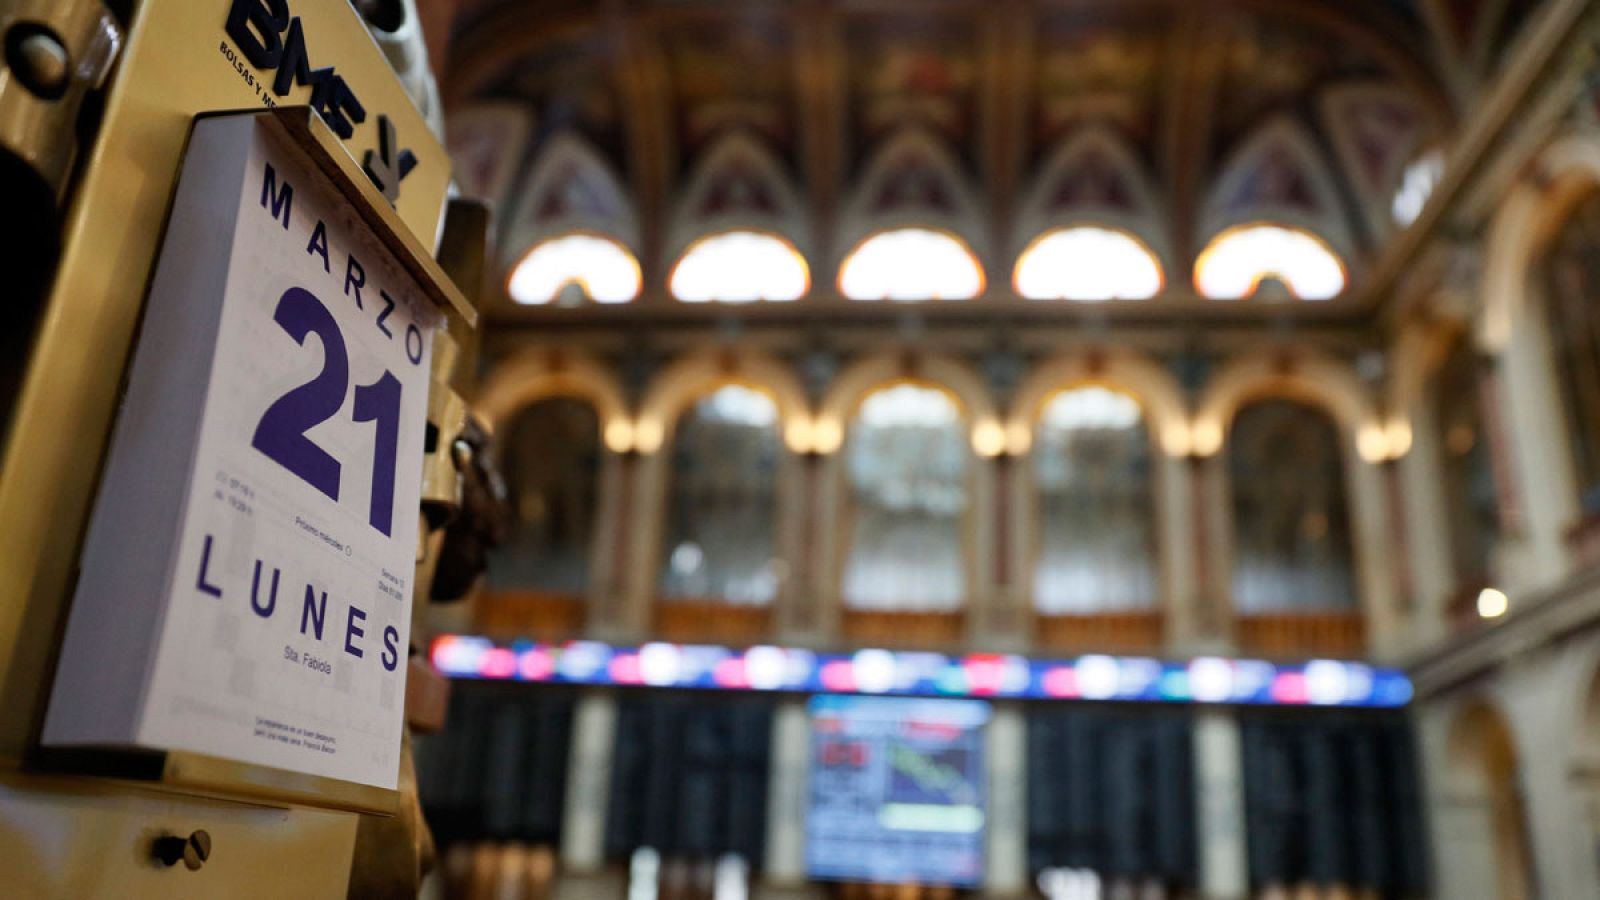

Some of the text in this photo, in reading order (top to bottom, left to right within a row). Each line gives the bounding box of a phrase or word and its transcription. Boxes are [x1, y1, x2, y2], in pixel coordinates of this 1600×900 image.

[219, 41, 255, 86] BOLSAS
[255, 82, 262, 95] Y
[260, 161, 423, 365] MARZO
[251, 286, 402, 538] 21
[196, 533, 399, 672] LUNES
[302, 652, 332, 675] Fabiola
